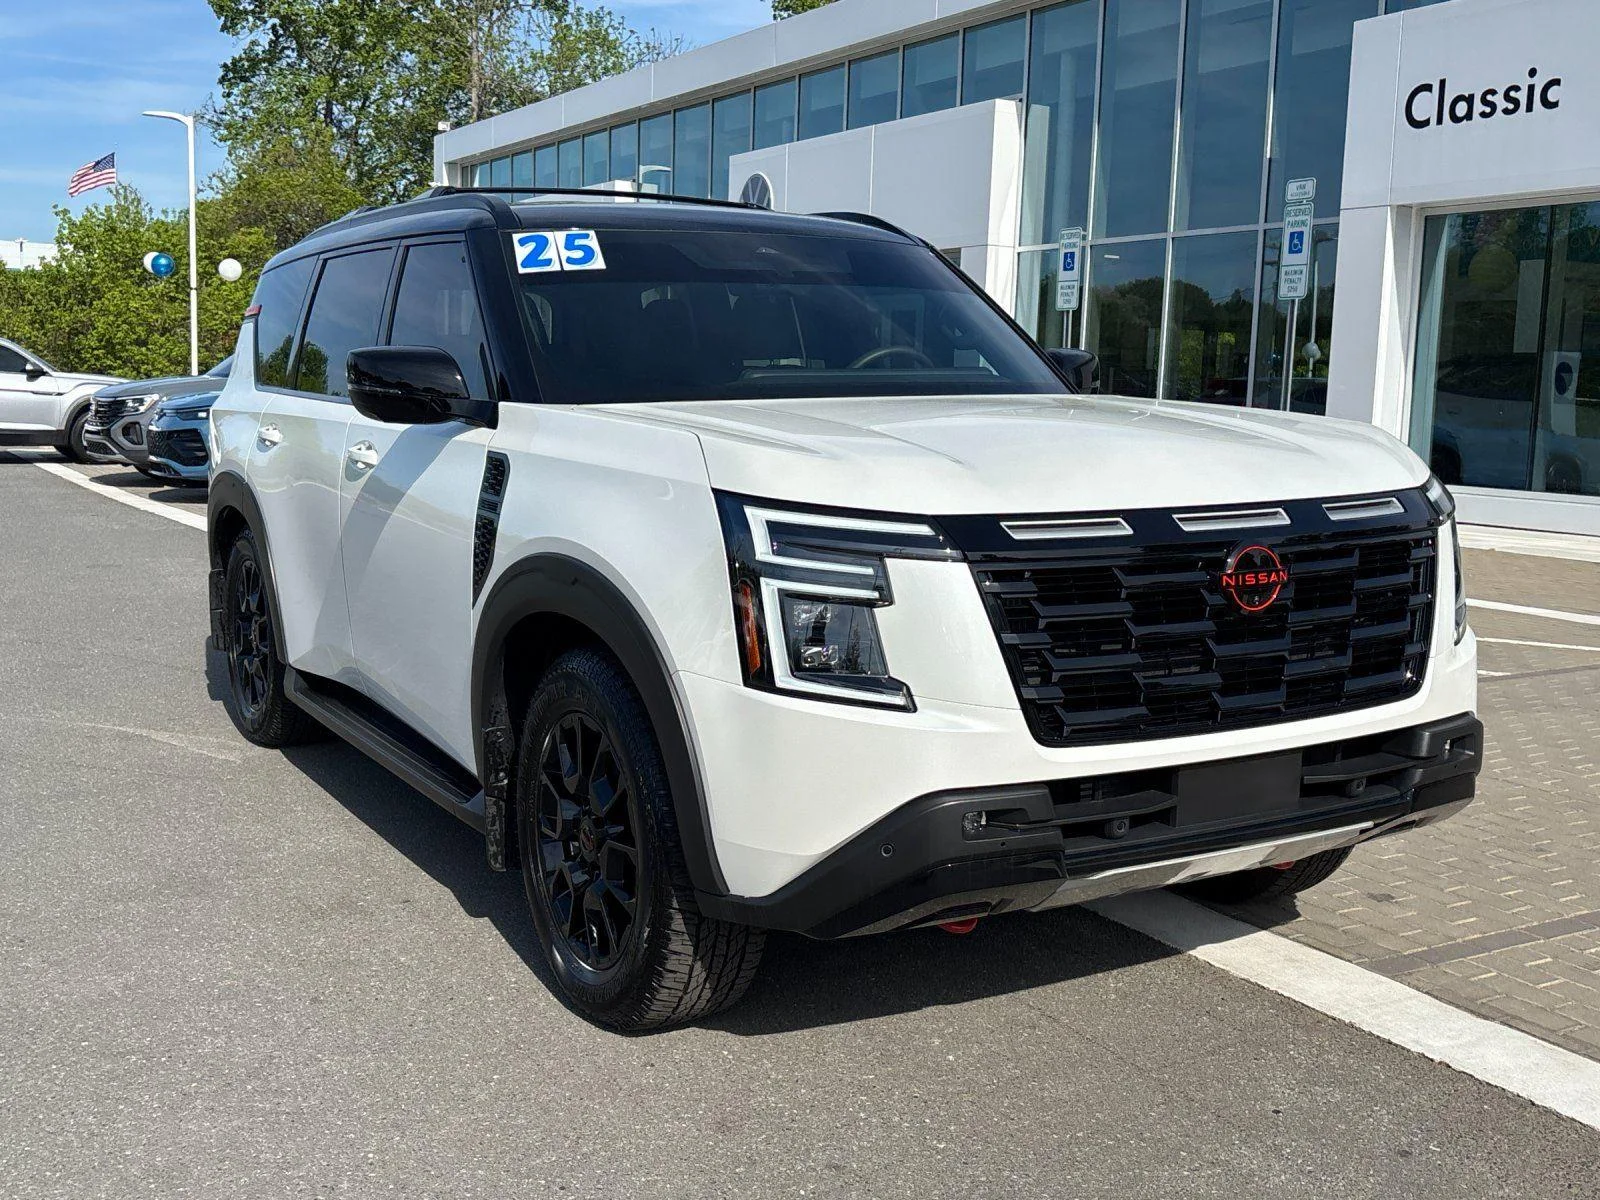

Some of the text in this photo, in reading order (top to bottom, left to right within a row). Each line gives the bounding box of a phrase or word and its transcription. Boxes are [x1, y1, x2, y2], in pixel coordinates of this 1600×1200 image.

[1404, 67, 1562, 129] Classic
[1285, 206, 1311, 217] RESERVED
[1286, 218, 1309, 228] PARKING
[517, 232, 596, 269] 25
[1222, 570, 1288, 587] NISSAN
